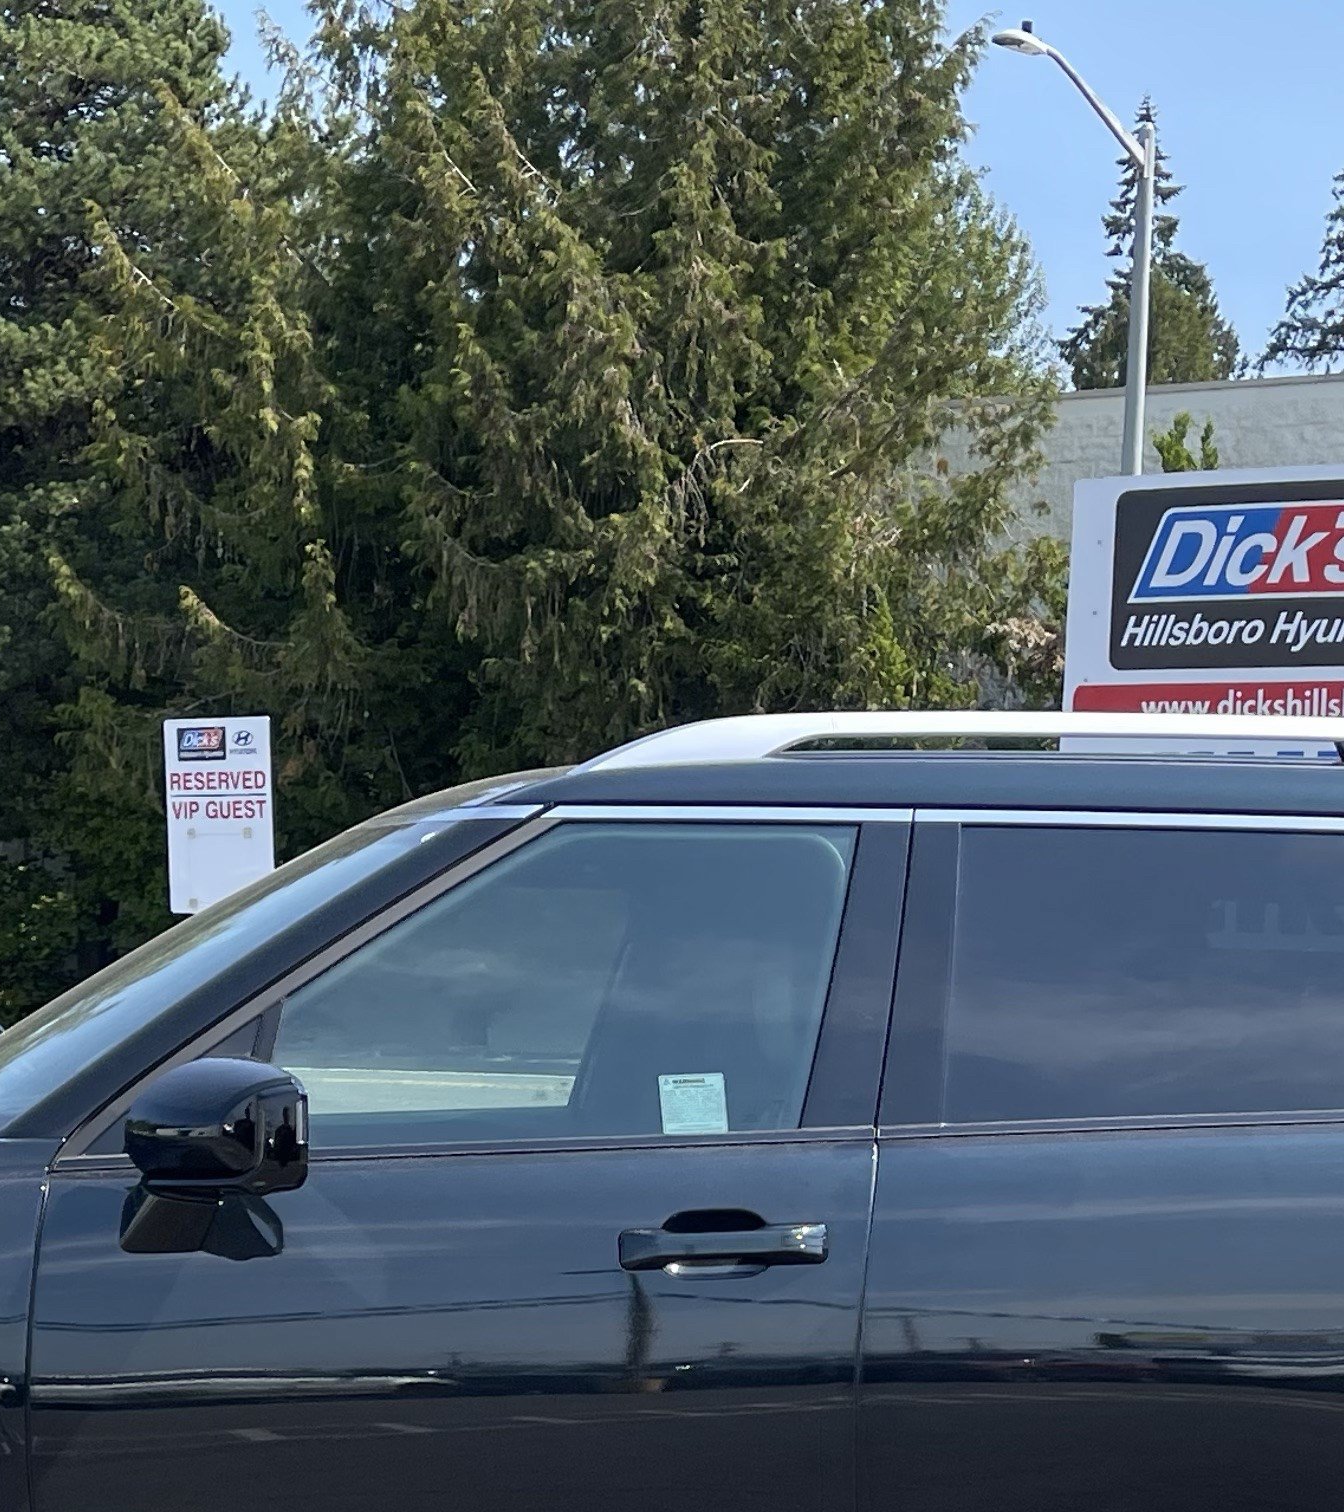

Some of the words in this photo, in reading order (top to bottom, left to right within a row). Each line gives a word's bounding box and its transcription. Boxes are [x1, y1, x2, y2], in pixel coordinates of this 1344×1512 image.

[1121, 613, 1265, 647] Hillsboro
[170, 771, 266, 790] RESERVED
[172, 801, 199, 819] VIP
[205, 800, 266, 819] GUEST
